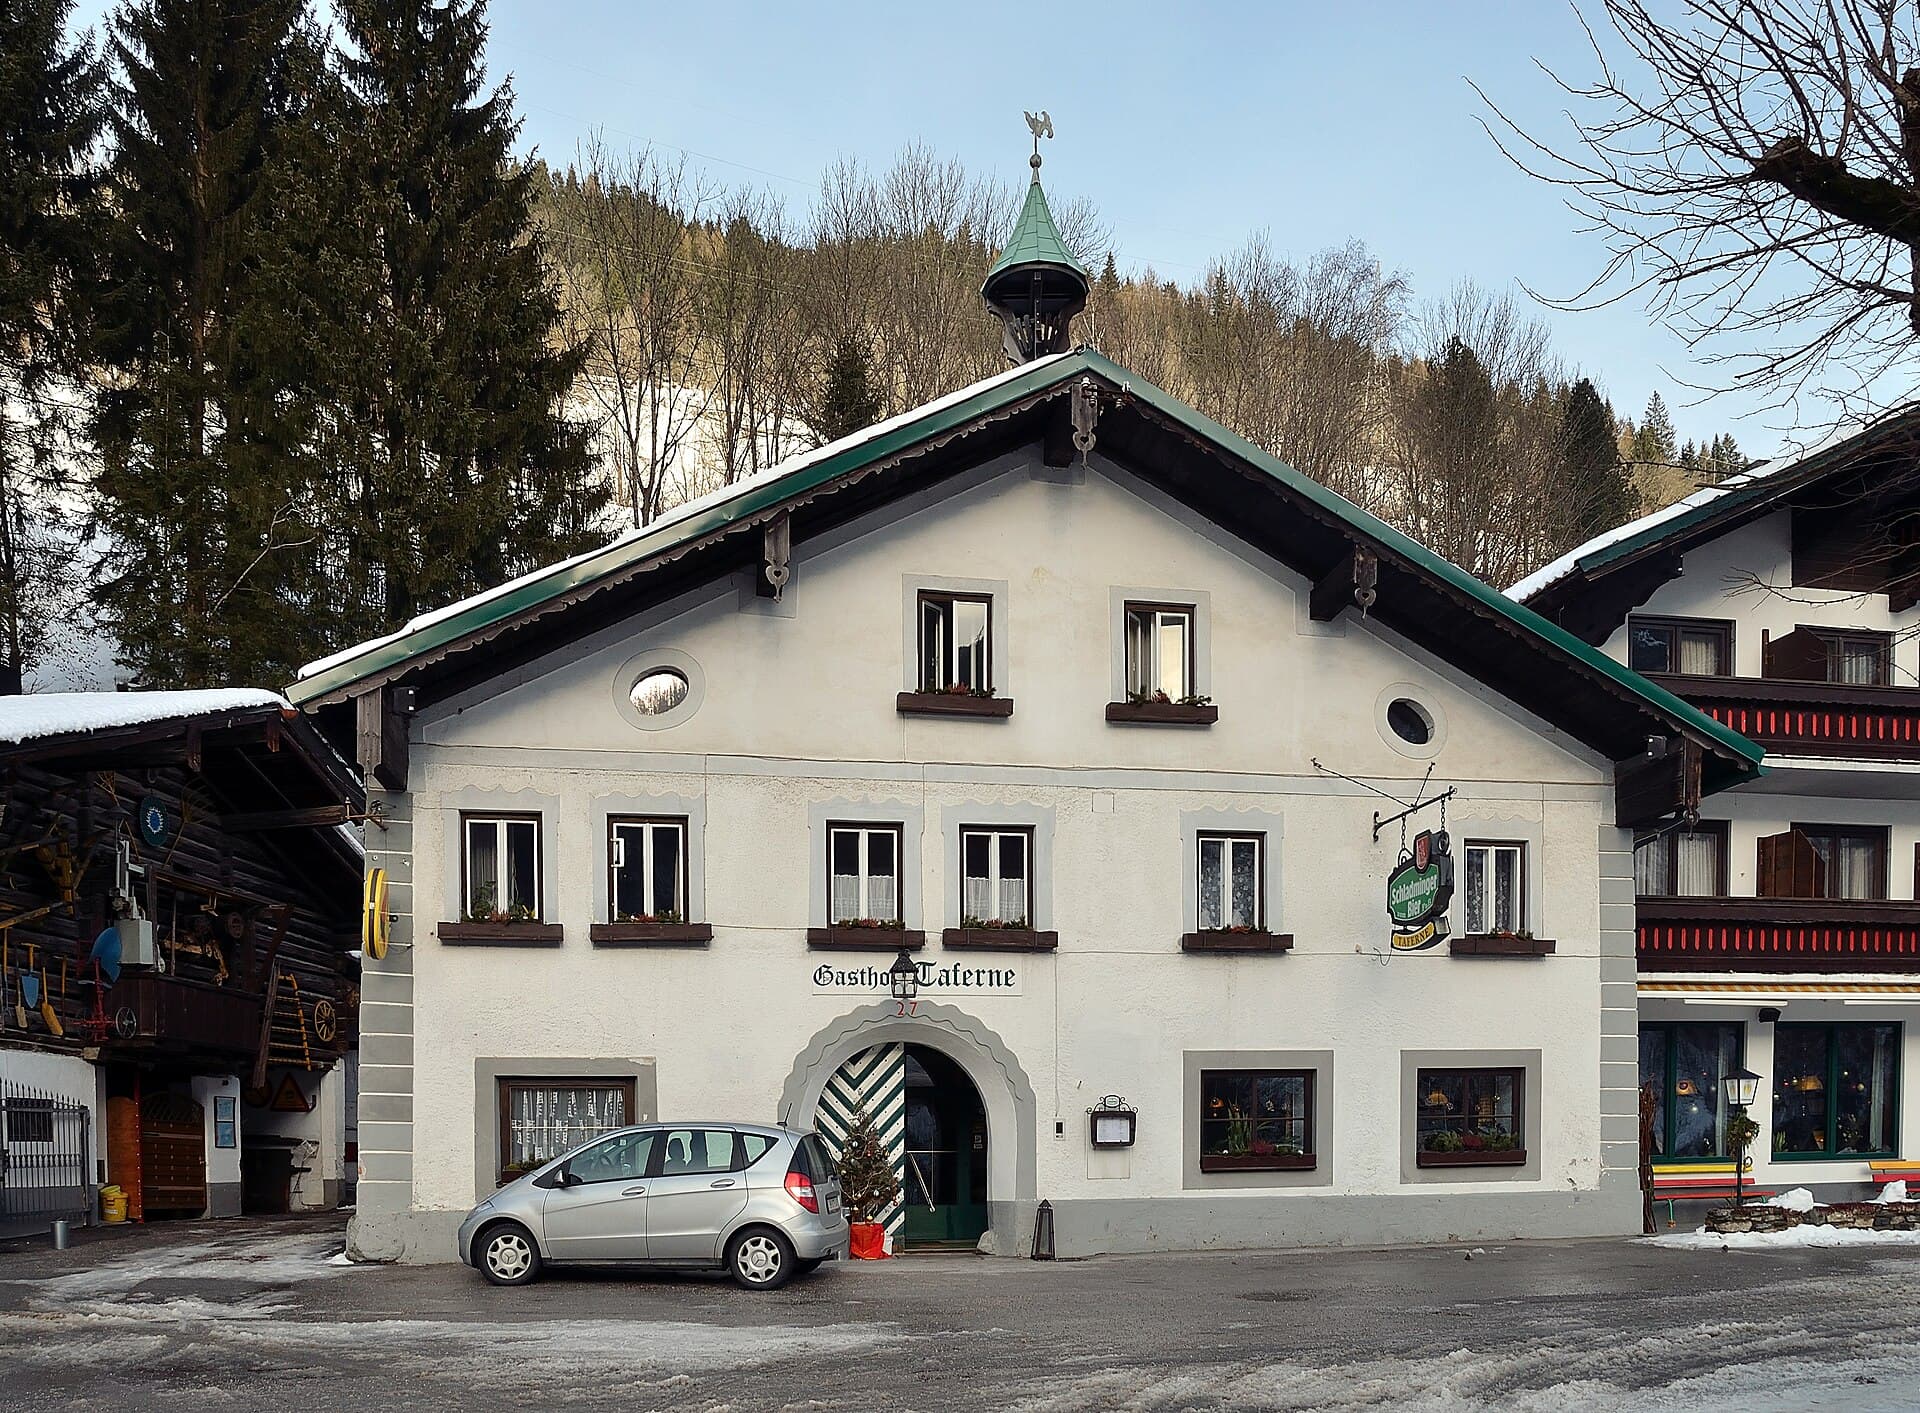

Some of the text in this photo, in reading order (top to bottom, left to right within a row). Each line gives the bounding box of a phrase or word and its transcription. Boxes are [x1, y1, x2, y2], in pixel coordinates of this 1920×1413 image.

[1392, 874, 1437, 905] Schladminger
[1407, 899, 1421, 918] Bier
[1397, 927, 1430, 947] TAFERNE
[813, 961, 1016, 989] Gastho Taferne
[896, 1001, 918, 1016] 27
